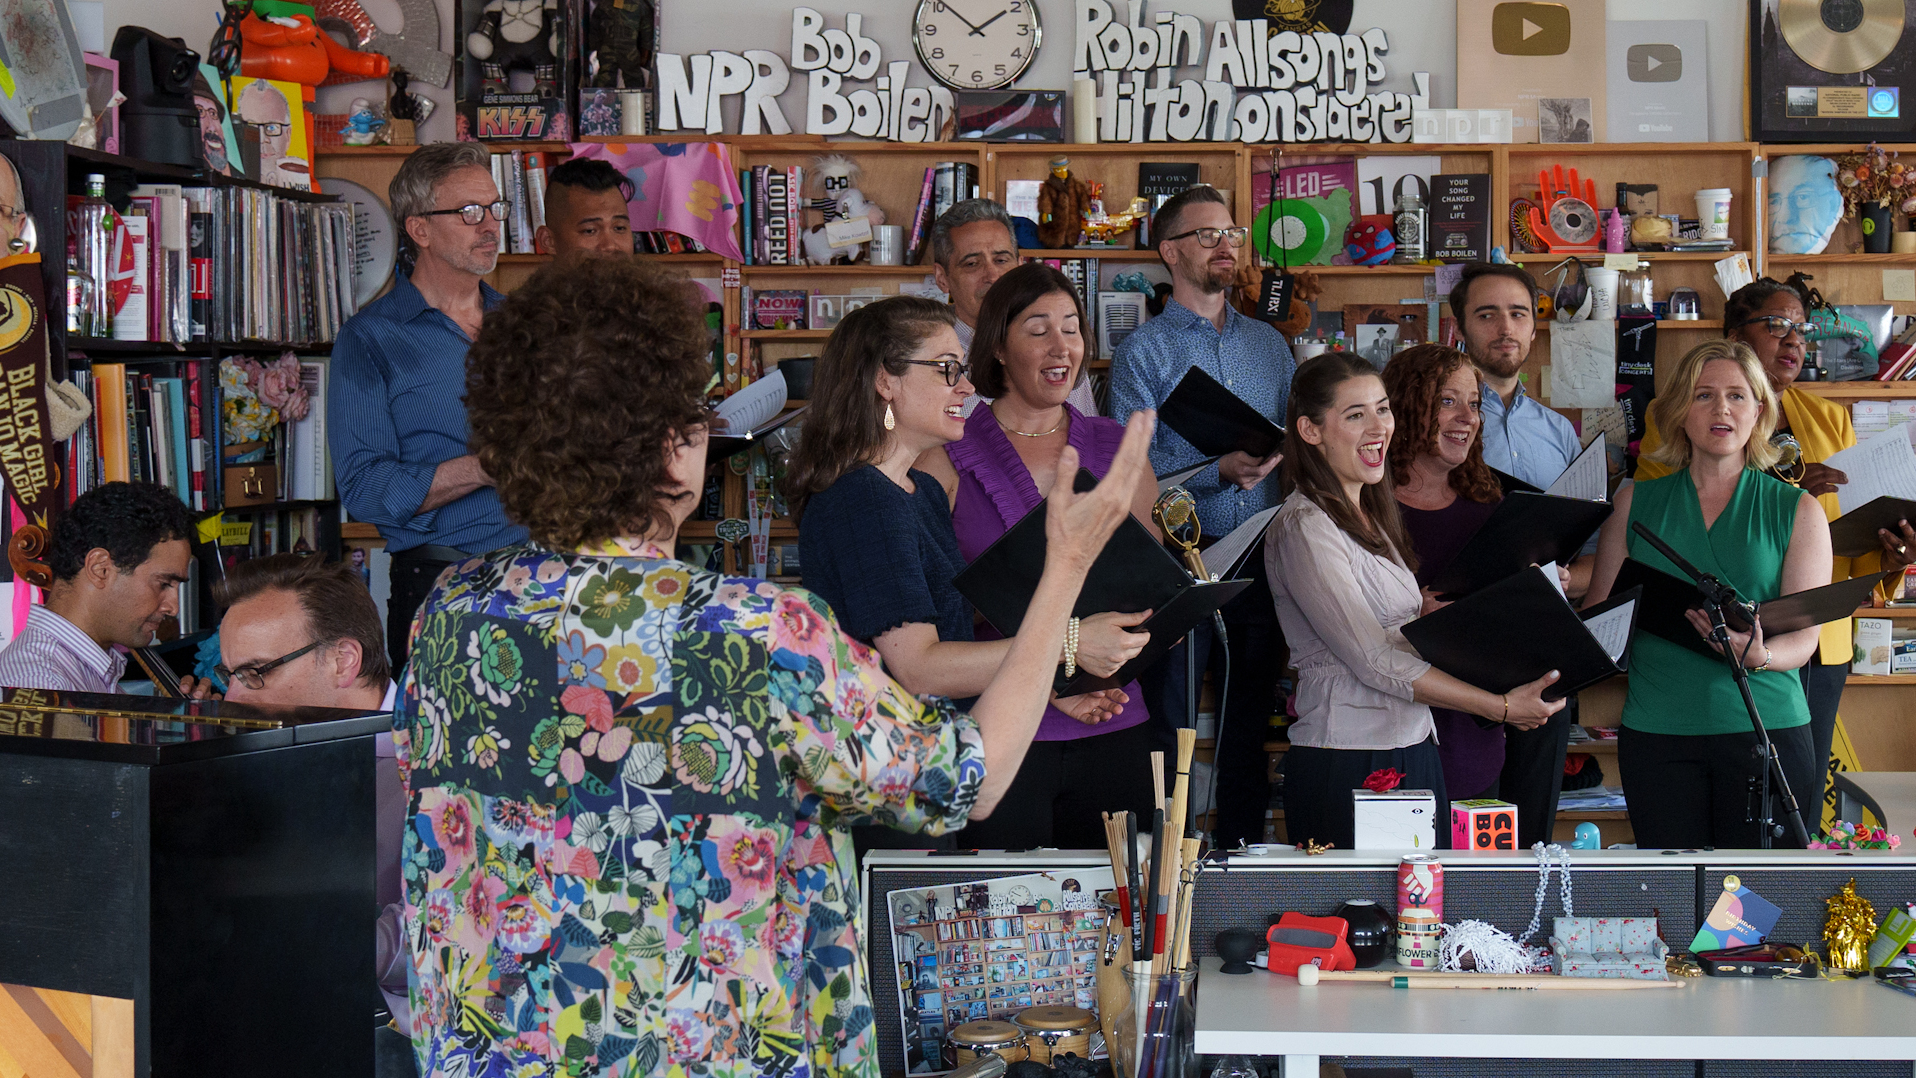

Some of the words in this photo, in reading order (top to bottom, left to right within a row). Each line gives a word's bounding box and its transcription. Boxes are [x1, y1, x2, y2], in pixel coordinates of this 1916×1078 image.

[1010, 1, 1022, 13] 2
[925, 24, 937, 36] 9
[1016, 24, 1029, 36] 3
[1074, 0, 1203, 72] Robin
[1278, 21, 1313, 33] KANSAS
[791, 6, 881, 83] Bob
[931, 47, 945, 59] 8
[1010, 47, 1022, 59] 4
[948, 64, 959, 76] 7
[994, 64, 1006, 76] 5
[1205, 19, 1389, 108] Allsongs
[971, 70, 983, 82] 6
[484, 95, 499, 104] GENE
[500, 95, 522, 104] SIMMONS
[524, 95, 538, 104] BEAR
[656, 50, 792, 135] NPR
[806, 60, 954, 143] Boilen
[1232, 72, 1430, 143] onsidere
[477, 106, 547, 138] KISS
[1420, 115, 1502, 137] npr
[288, 183, 310, 193] WISH
[768, 175, 786, 209] LOU
[788, 173, 796, 191] ASK
[1285, 171, 1321, 199] LED
[788, 192, 796, 213] BOB
[1363, 174, 1431, 215] 10
[1441, 195, 1476, 203] CHANGED
[769, 217, 787, 264] REED
[1435, 250, 1450, 258] BOB
[758, 298, 800, 309] NOW
[758, 315, 798, 327] CHRISMAS
[1811, 315, 1869, 342] RGANISM
[7, 363, 42, 443] BLACK
[3, 442, 38, 505] MAGIC
[23, 442, 49, 494] GIRL
[221, 526, 250, 537] LAYBILL
[1860, 621, 1882, 630] TAZO
[1476, 814, 1492, 848] BO
[1494, 812, 1514, 850] CU
[1131, 911, 1141, 935] FIRTH
[1725, 910, 1757, 932] BIRTHDAY
[1725, 918, 1749, 936] WISHES
